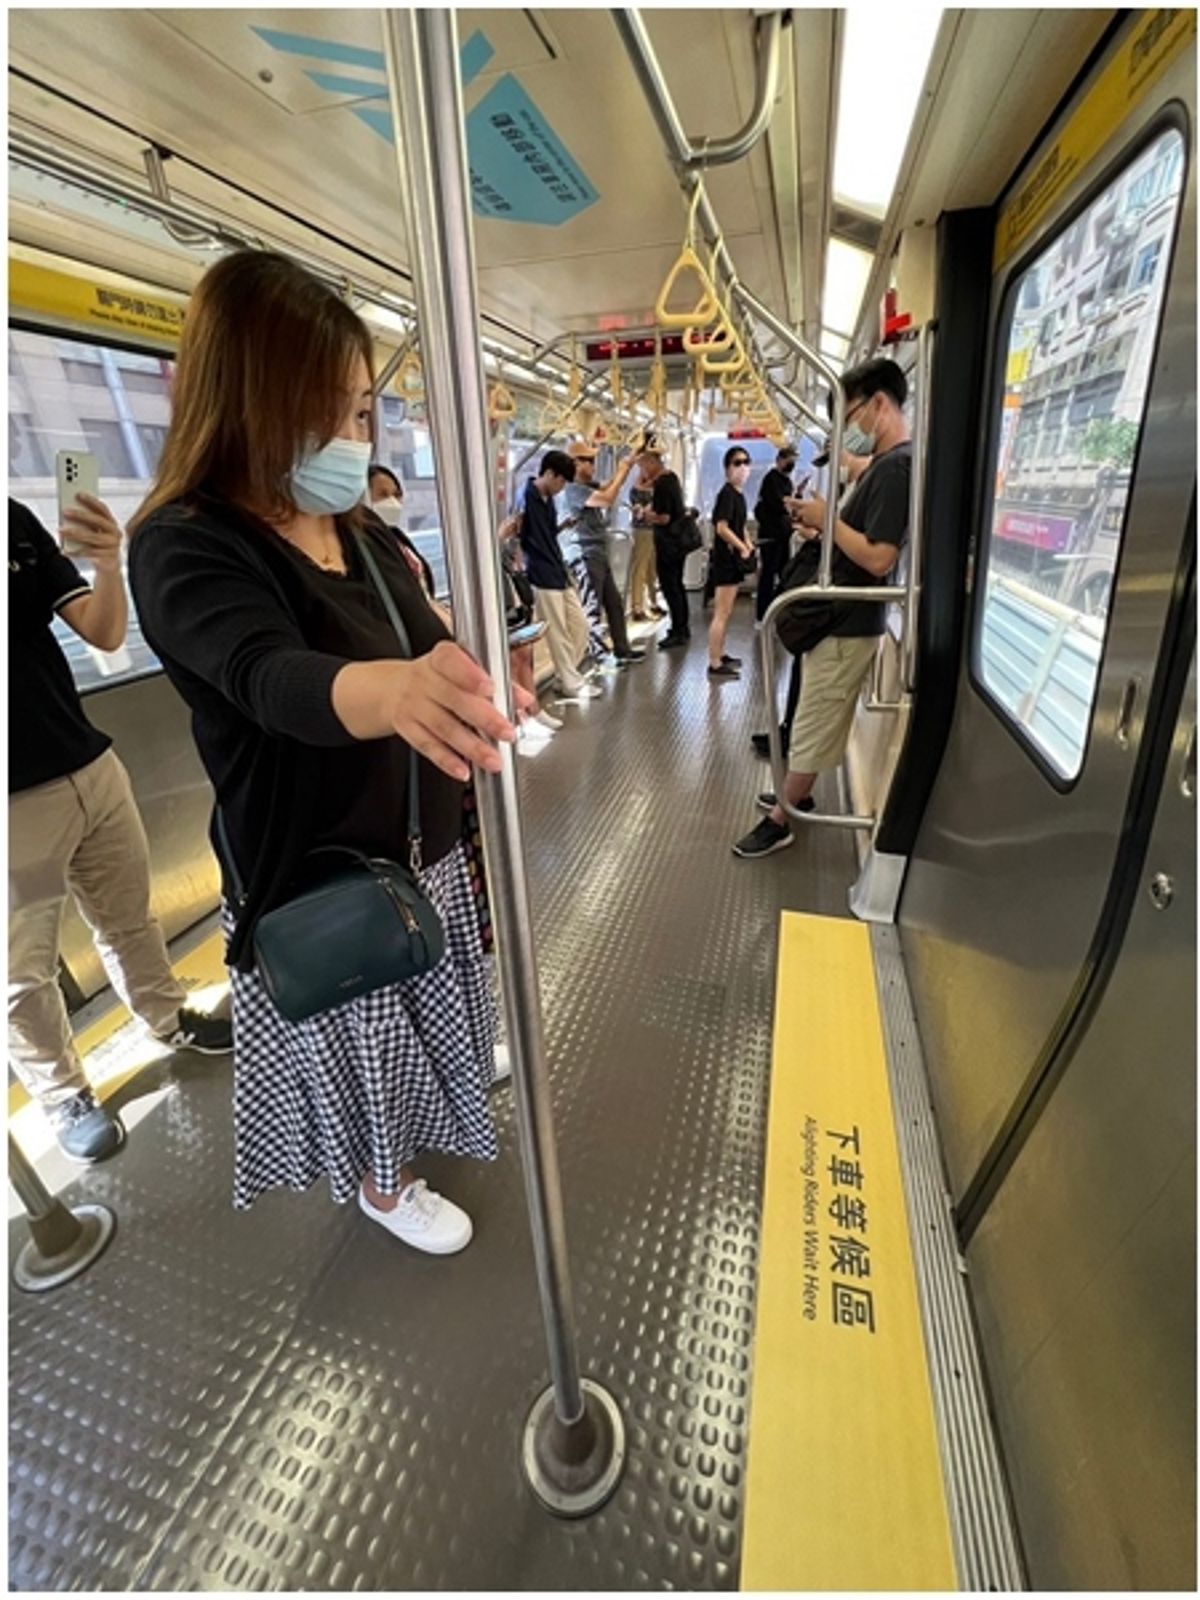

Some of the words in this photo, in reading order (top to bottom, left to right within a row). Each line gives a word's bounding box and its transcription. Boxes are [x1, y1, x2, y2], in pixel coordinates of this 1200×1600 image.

[800, 1115, 817, 1177] Alighting
[803, 1178, 819, 1227] Riders
[803, 1229, 820, 1271] Wait
[826, 1126, 875, 1334] 下車等候區
[802, 1273, 819, 1321] Here
